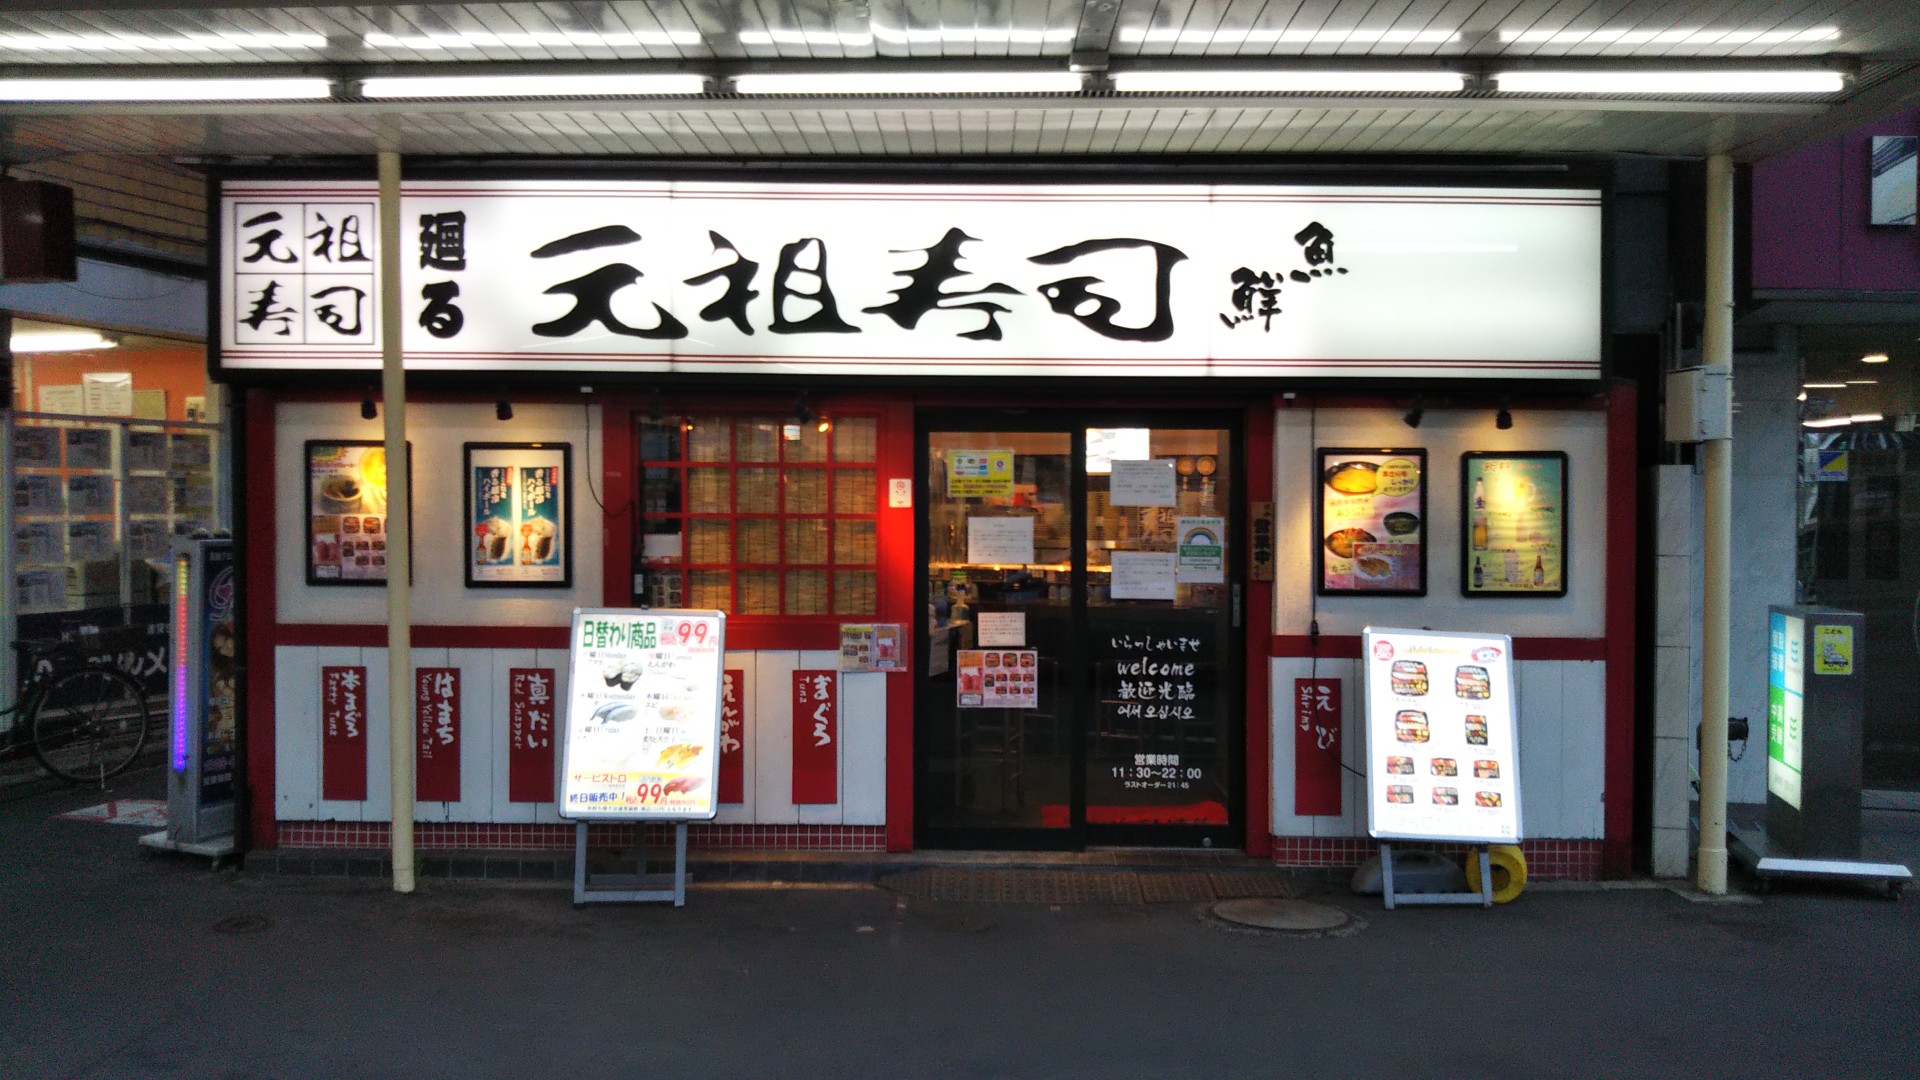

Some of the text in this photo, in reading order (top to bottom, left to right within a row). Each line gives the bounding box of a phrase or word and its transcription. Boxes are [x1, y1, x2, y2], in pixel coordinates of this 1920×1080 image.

[418, 210, 467, 338] 廻る
[529, 223, 1189, 342] 元祖寿司
[583, 620, 657, 649] 日替わり商品
[1111, 634, 1200, 652] いらっしゃいませ
[1117, 656, 1195, 676] welcome
[434, 672, 455, 746] はまち
[527, 672, 550, 749] 真だい
[799, 675, 810, 705] Tuna
[812, 674, 832, 748] まぐろ
[1117, 704, 1196, 720] 어서 오십시오
[1300, 685, 1313, 732] Shrimp
[421, 673, 433, 759] Young Yellow Tail
[513, 702, 526, 750] Snapper
[1314, 684, 1340, 750] えび
[574, 774, 627, 784] サービストロ
[1134, 754, 1180, 766] 営業時間
